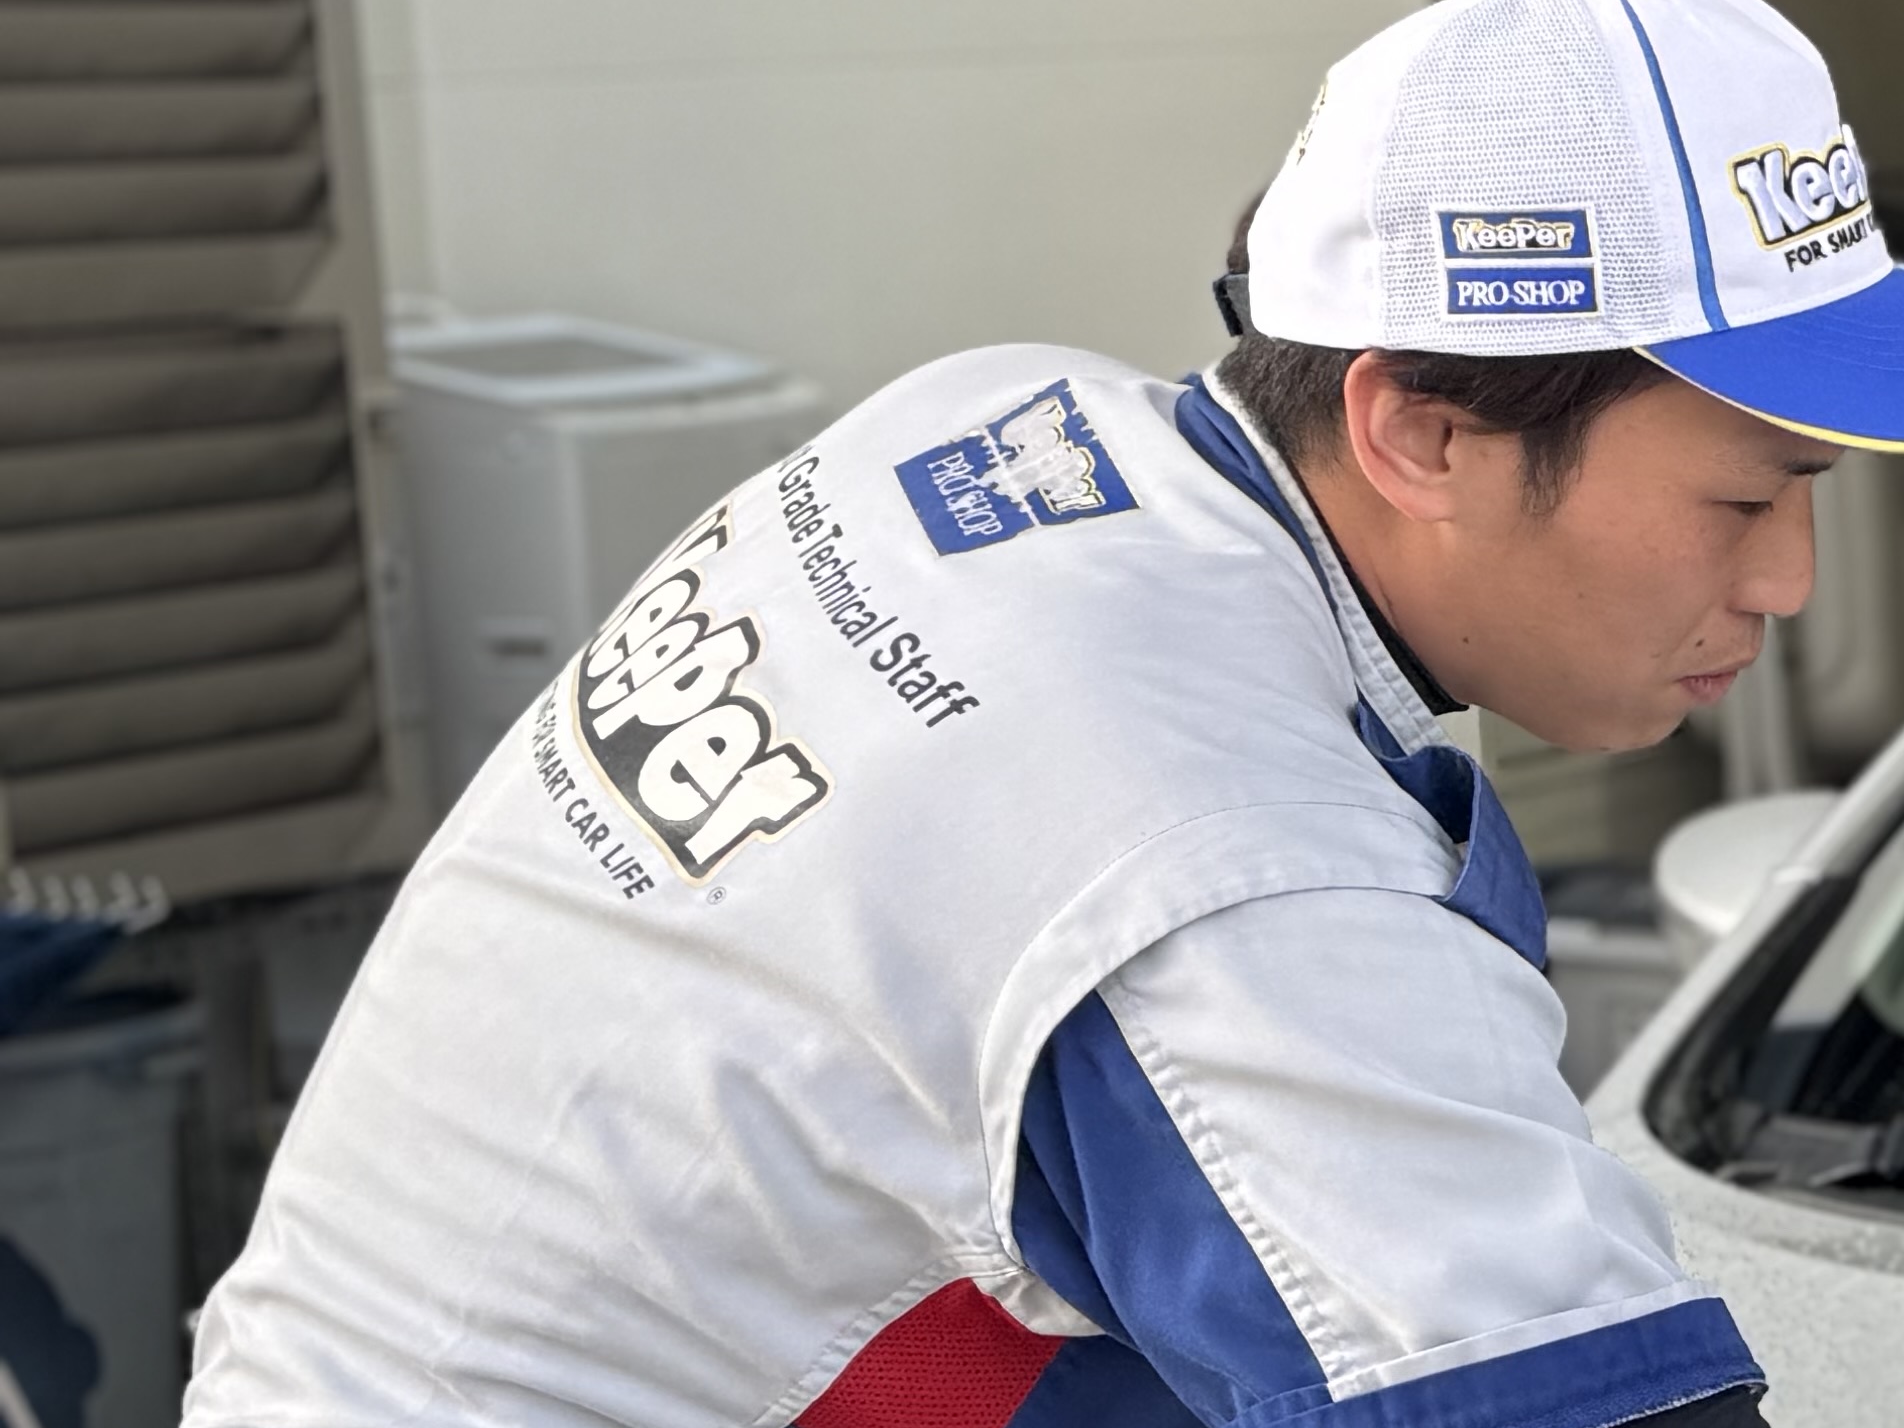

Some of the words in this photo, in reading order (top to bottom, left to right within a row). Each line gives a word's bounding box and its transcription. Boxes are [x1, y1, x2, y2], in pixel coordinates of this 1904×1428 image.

[1733, 123, 1868, 243] Kee
[1452, 219, 1574, 251] KeePer
[1784, 240, 1828, 273] FOR
[778, 456, 832, 544] Grade
[797, 522, 899, 649] Technical
[869, 631, 981, 729] Staff
[564, 797, 610, 853] CAR
[599, 842, 656, 900] LIFE
